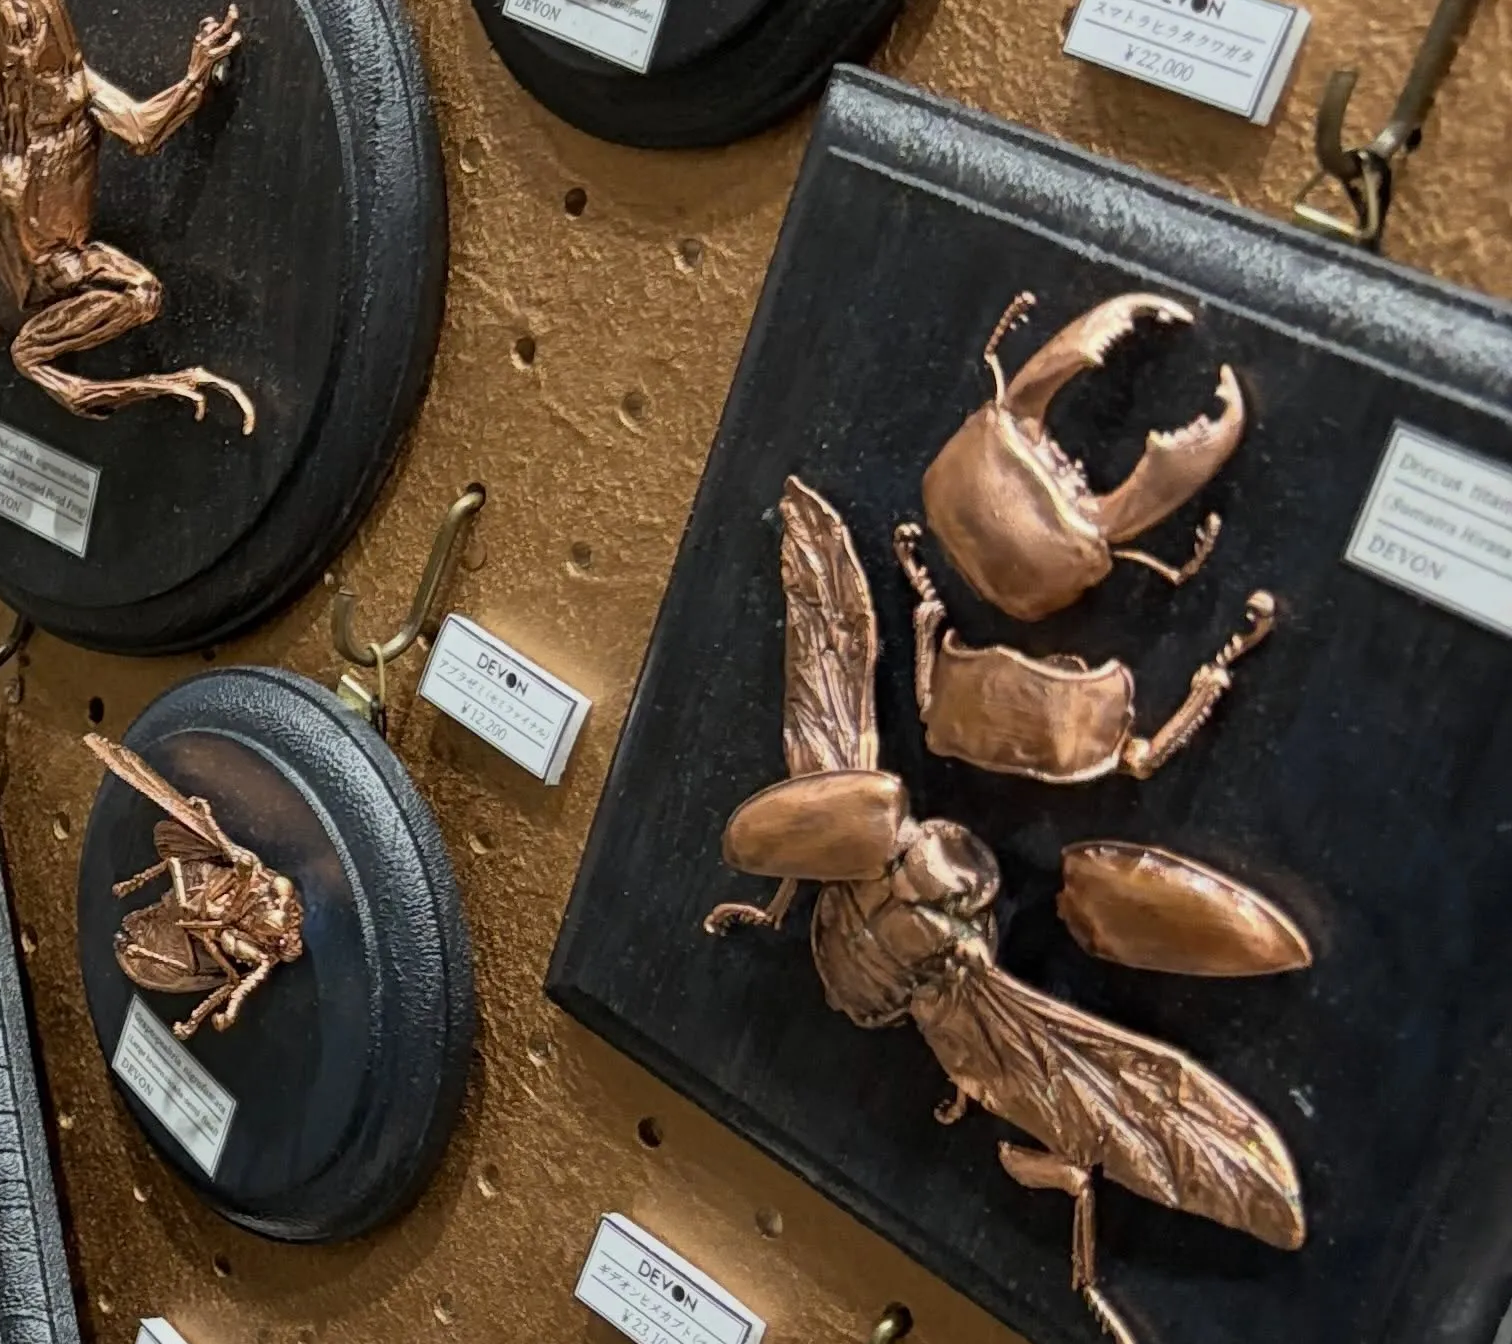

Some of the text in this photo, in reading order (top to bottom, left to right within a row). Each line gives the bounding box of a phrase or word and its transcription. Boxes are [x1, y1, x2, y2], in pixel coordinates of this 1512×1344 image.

[1121, 42, 1197, 85] ¥22,000
[1367, 531, 1448, 585] DEVON
[475, 650, 530, 698] DEVON
[120, 1054, 154, 1098] DEVON
[636, 1257, 699, 1314] DEVON
